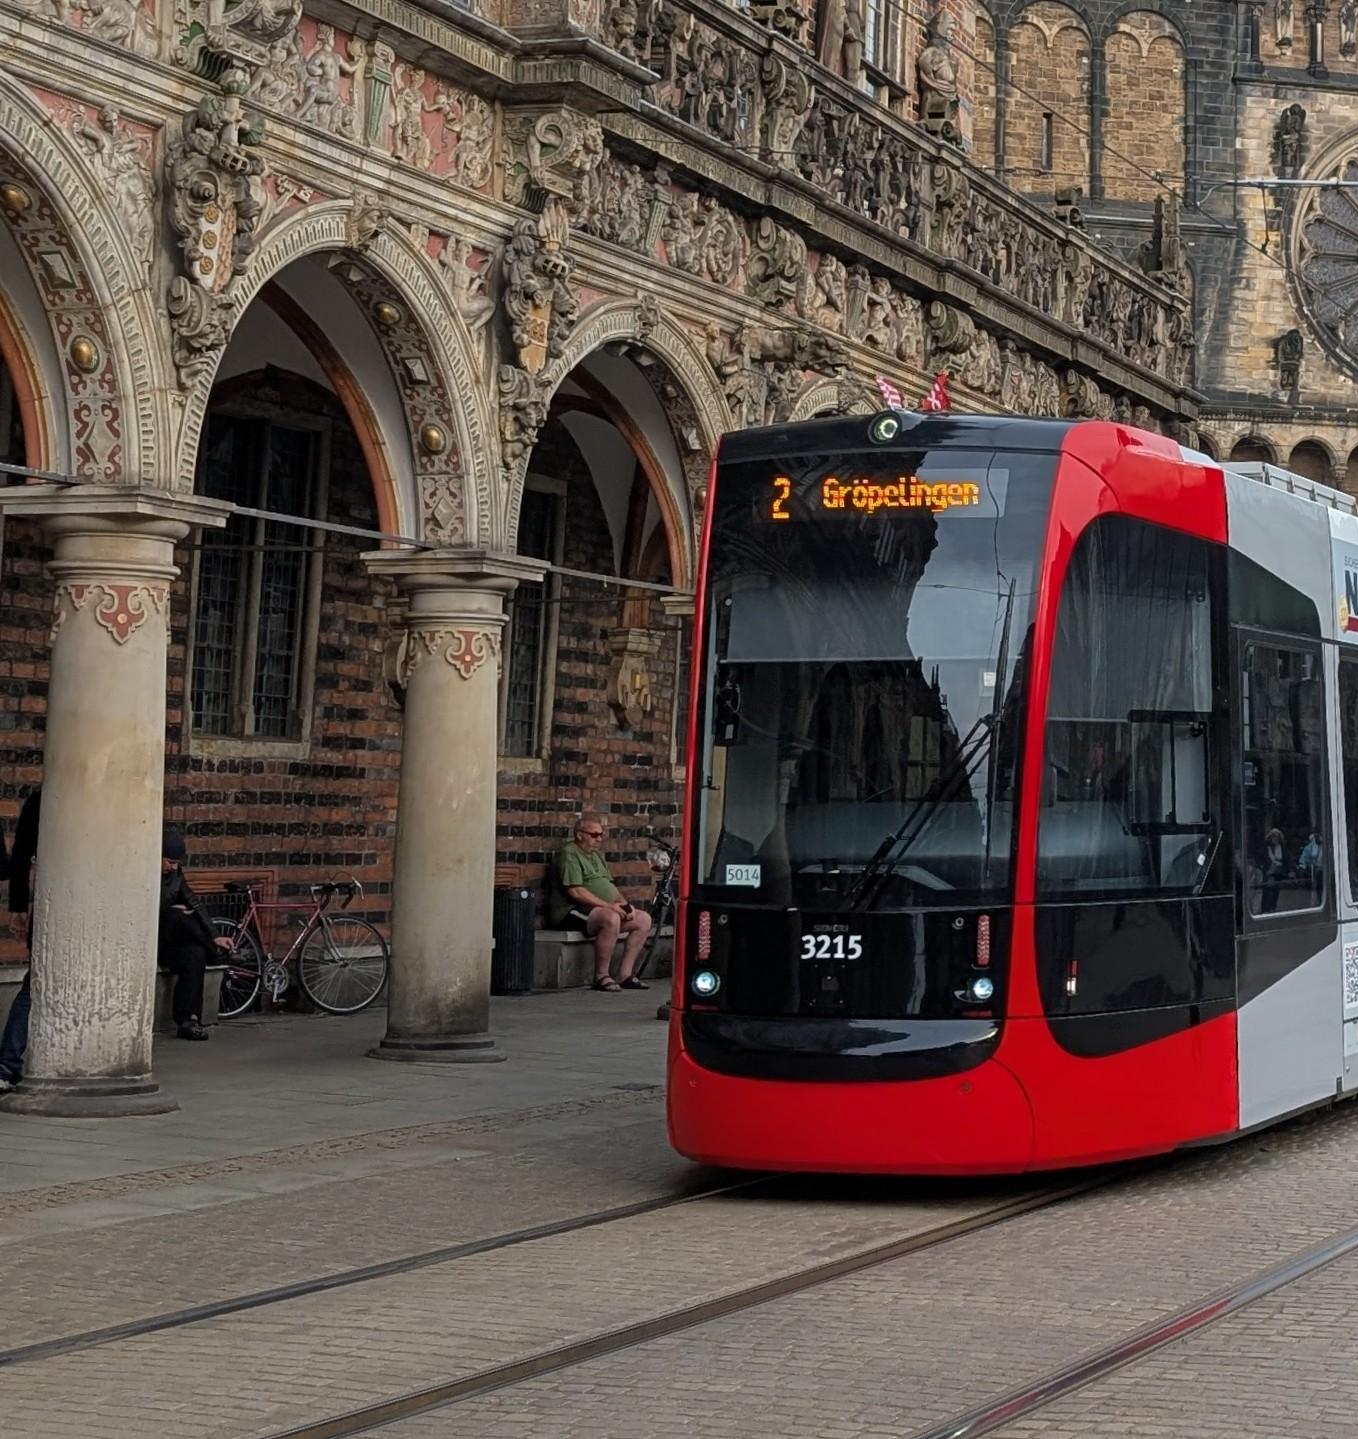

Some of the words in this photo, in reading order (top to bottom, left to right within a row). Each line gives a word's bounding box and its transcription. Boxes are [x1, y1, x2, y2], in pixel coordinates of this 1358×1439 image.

[772, 477, 791, 520] 2
[822, 476, 980, 514] Gröpelingen
[728, 868, 759, 881] 5014
[800, 934, 863, 960] 3215
